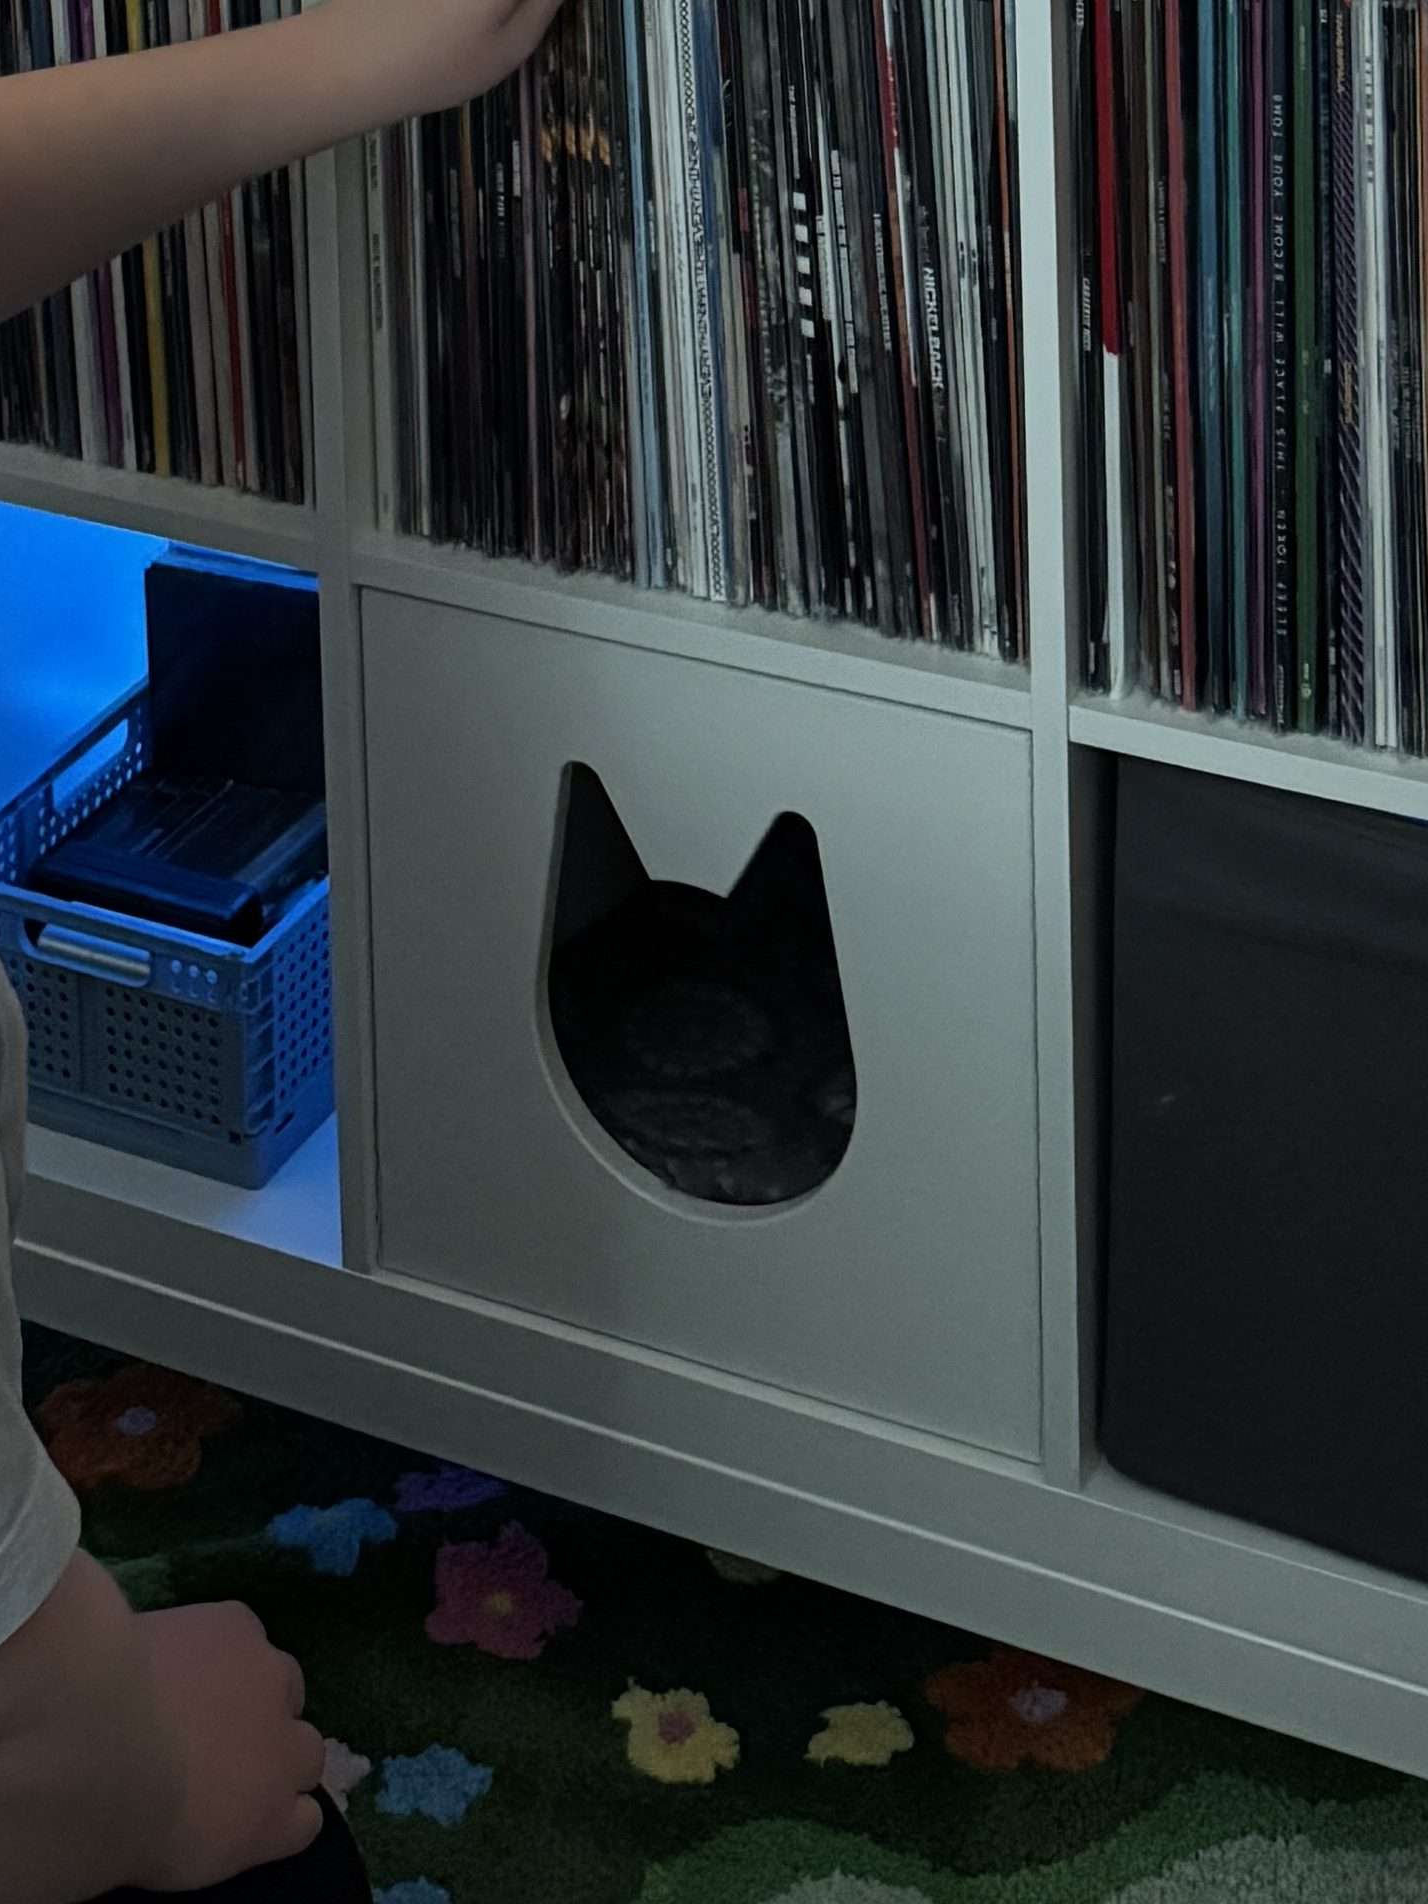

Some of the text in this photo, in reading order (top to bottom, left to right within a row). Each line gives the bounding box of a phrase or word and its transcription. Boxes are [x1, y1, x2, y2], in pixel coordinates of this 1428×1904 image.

[1272, 93, 1284, 138] TOMB
[1273, 153, 1284, 197] YOUR
[1273, 214, 1285, 283] BECOME
[922, 267, 945, 390] NICKELBACK
[1274, 299, 1285, 343] WILL
[1274, 358, 1286, 412] PLACE
[1275, 427, 1286, 472] THIS
[1276, 508, 1287, 565] TOKEN
